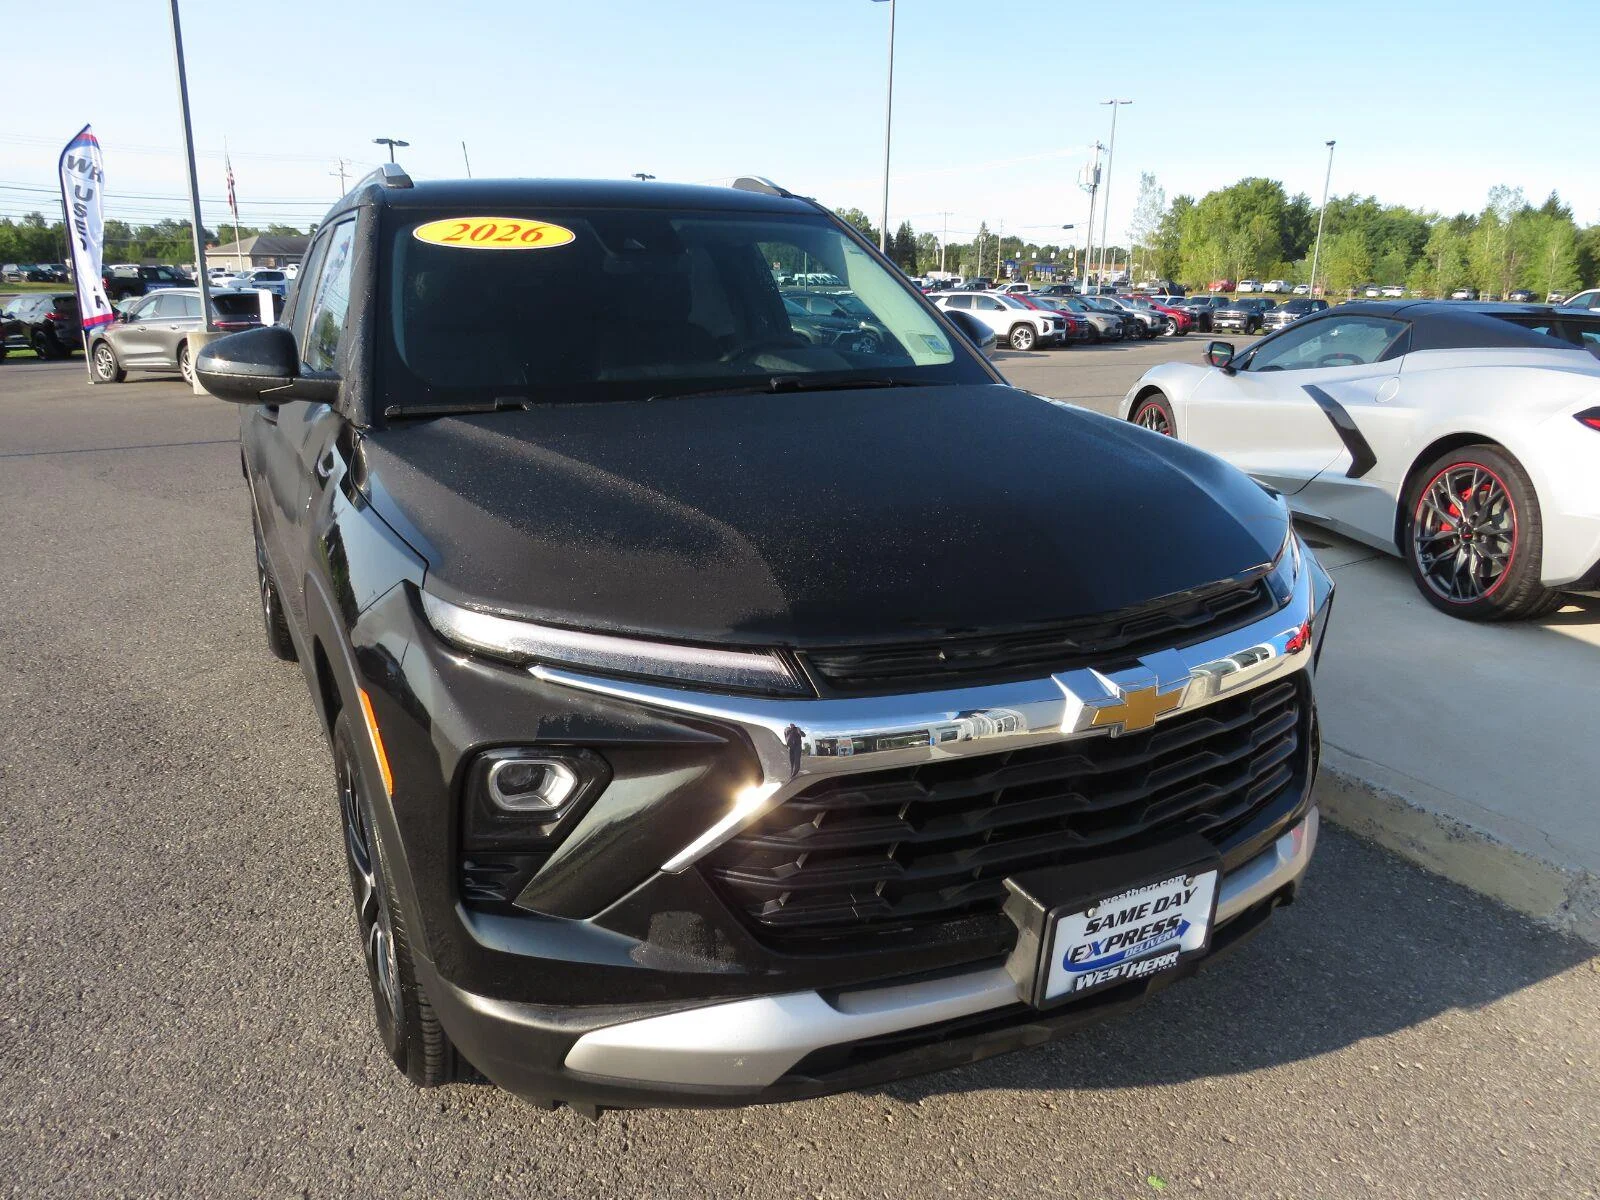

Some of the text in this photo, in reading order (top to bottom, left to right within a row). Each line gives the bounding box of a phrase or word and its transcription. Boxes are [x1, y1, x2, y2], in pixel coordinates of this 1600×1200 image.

[441, 223, 547, 243] 2026
[1099, 874, 1187, 907] westherr.com
[1083, 886, 1199, 937] SAME DAY
[1070, 913, 1183, 963] EXPRESS
[1124, 927, 1180, 959] DELIVERY
